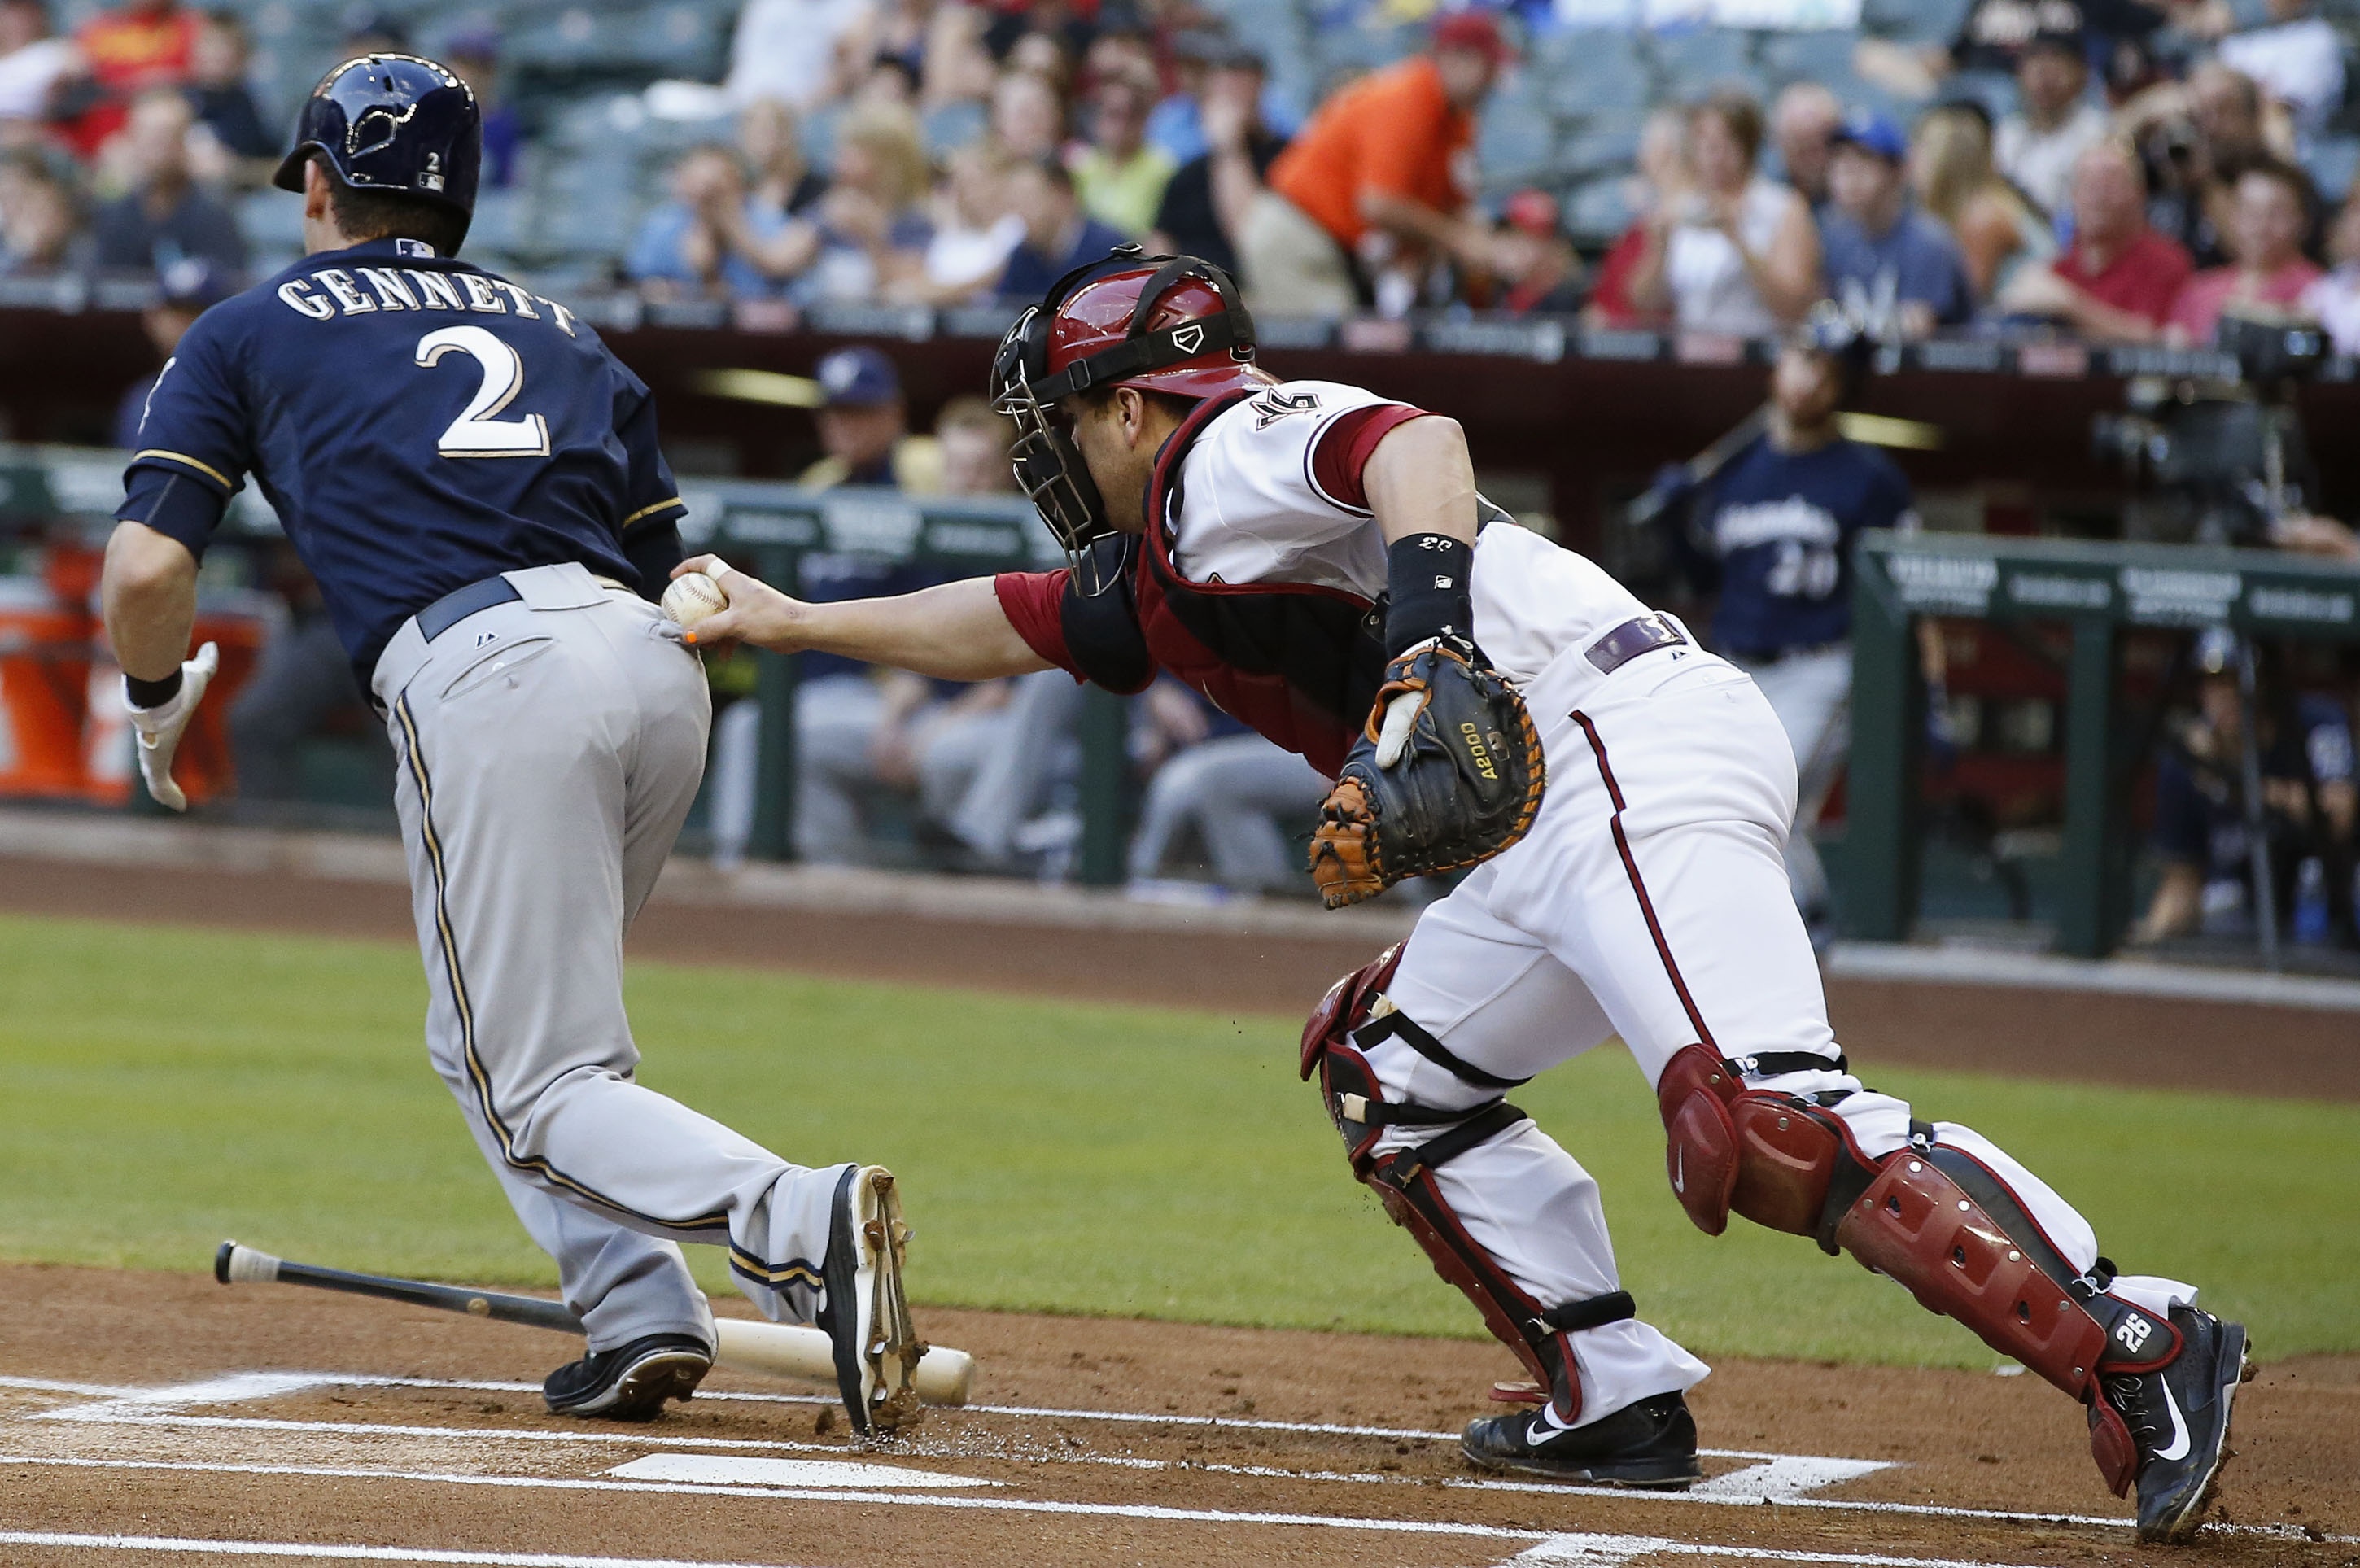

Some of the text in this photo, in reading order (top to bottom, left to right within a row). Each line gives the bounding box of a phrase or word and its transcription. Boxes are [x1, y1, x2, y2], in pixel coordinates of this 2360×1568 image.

[427, 152, 439, 173] 2
[278, 266, 576, 338] GENNETT
[415, 325, 551, 458] 2
[1460, 722, 1498, 780] A2000
[2116, 1312, 2152, 1354] 26
